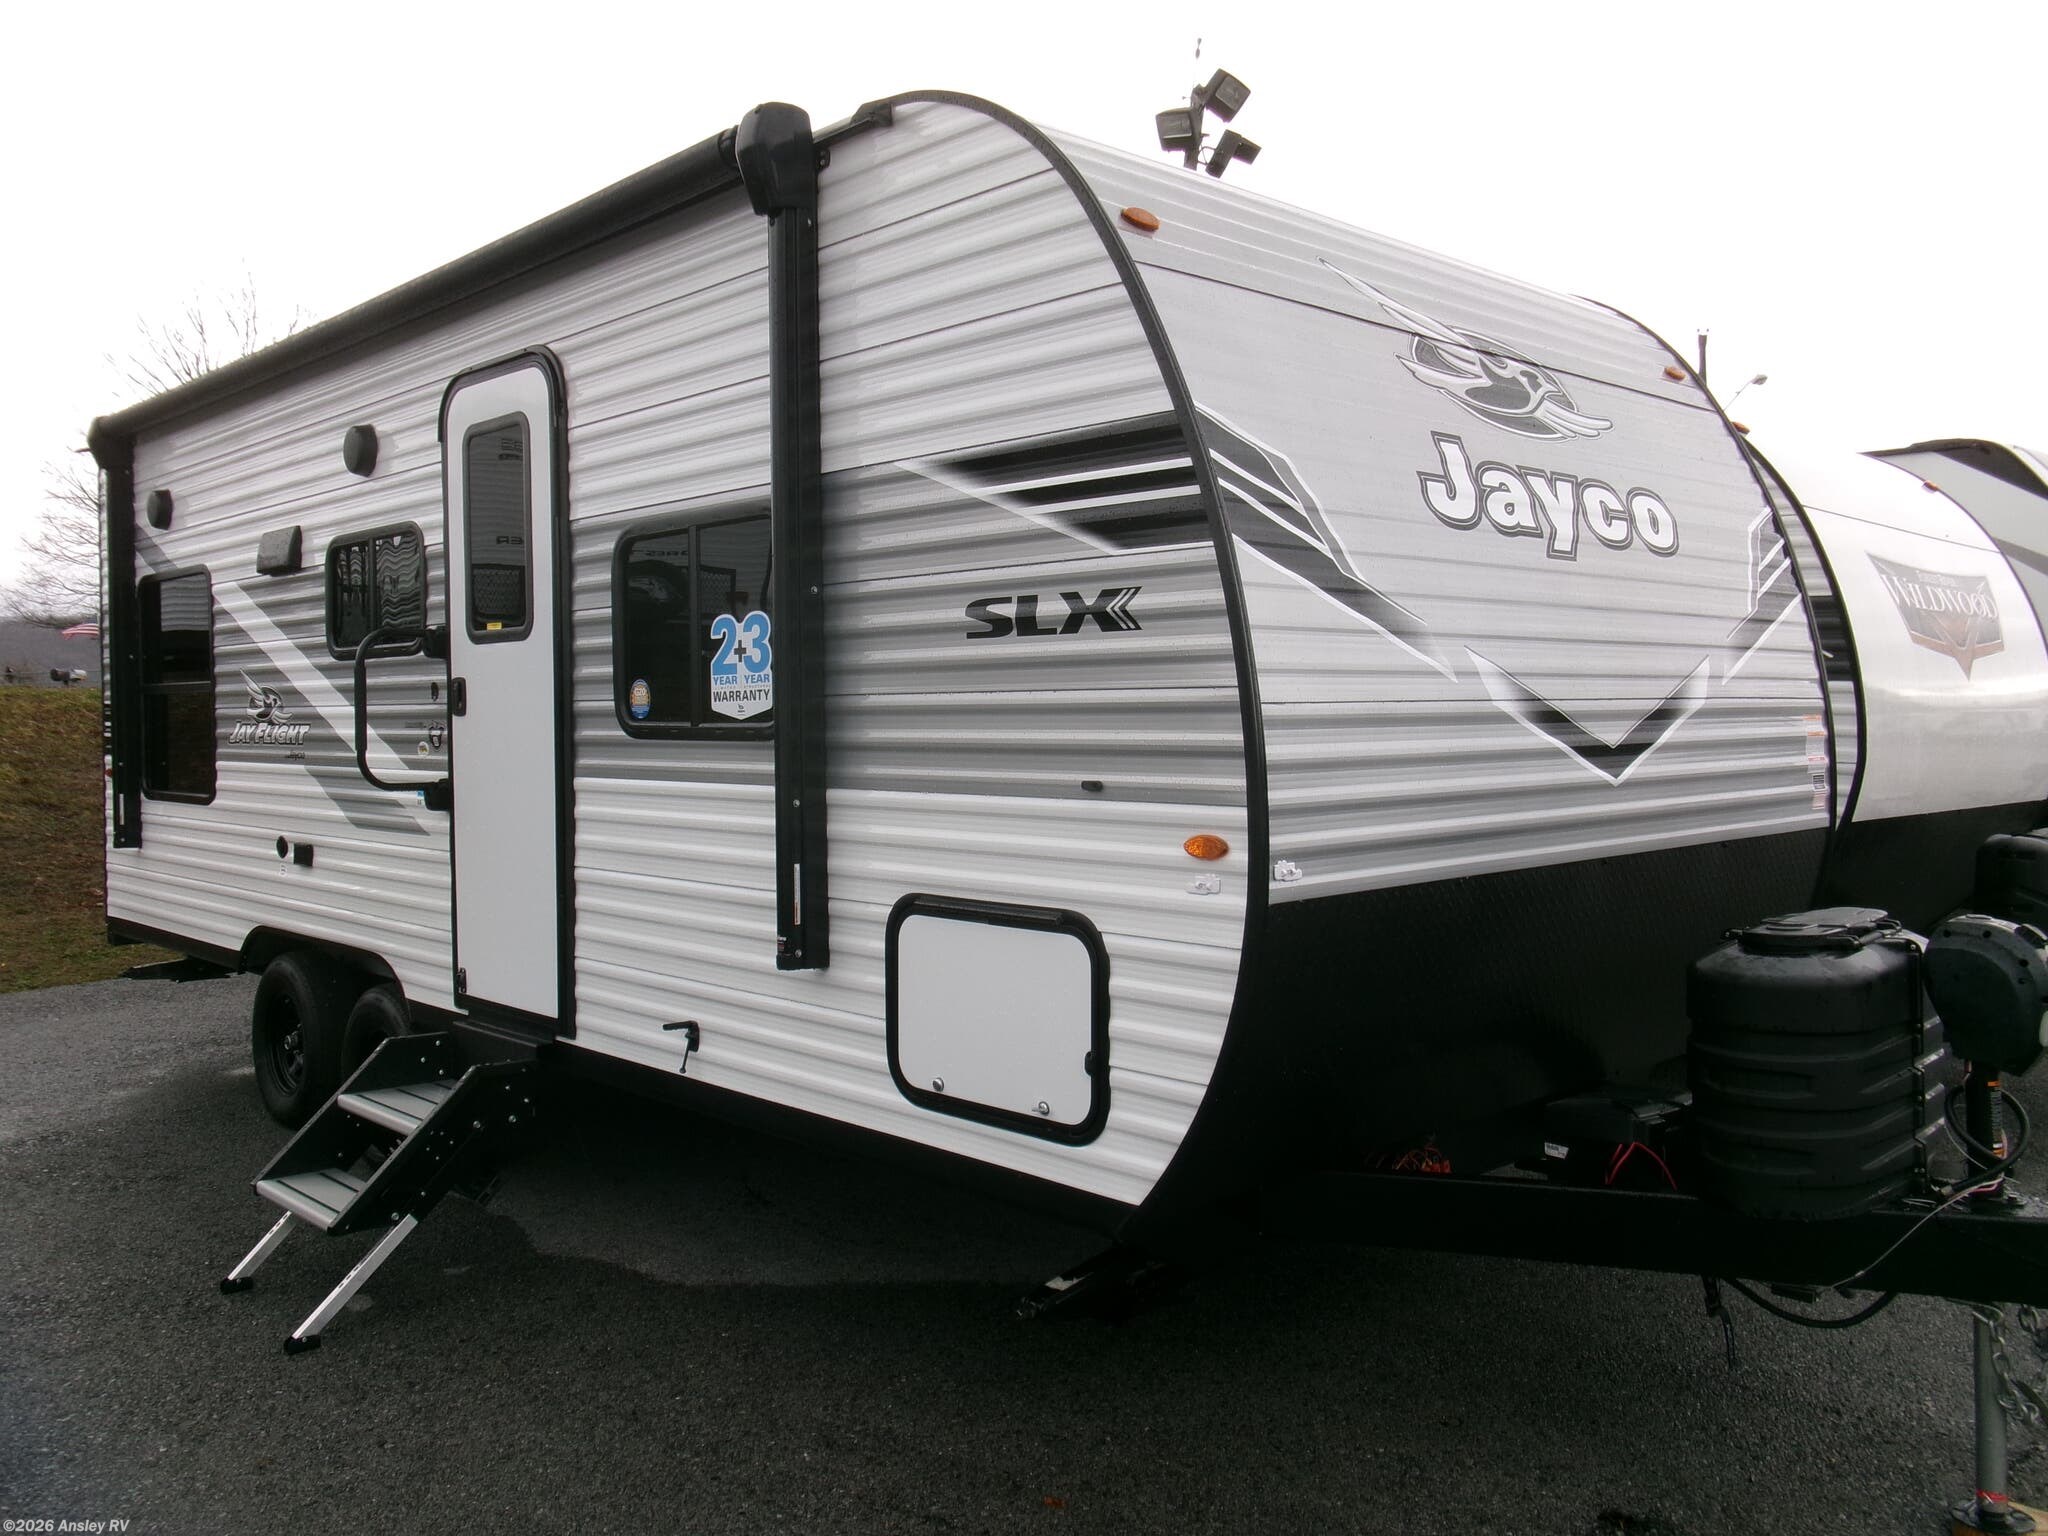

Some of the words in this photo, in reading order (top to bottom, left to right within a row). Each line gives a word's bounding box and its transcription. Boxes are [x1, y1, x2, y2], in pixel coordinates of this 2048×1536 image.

[1416, 430, 1680, 562] Jayco
[965, 586, 1143, 640] SLX
[1880, 573, 1999, 619] WILDWOOD
[713, 675, 738, 686] YEAR
[744, 673, 770, 684] YEAR
[713, 689, 770, 703] WARRANTY
[228, 720, 257, 745] JAY
[254, 722, 311, 746] FLIGHT
